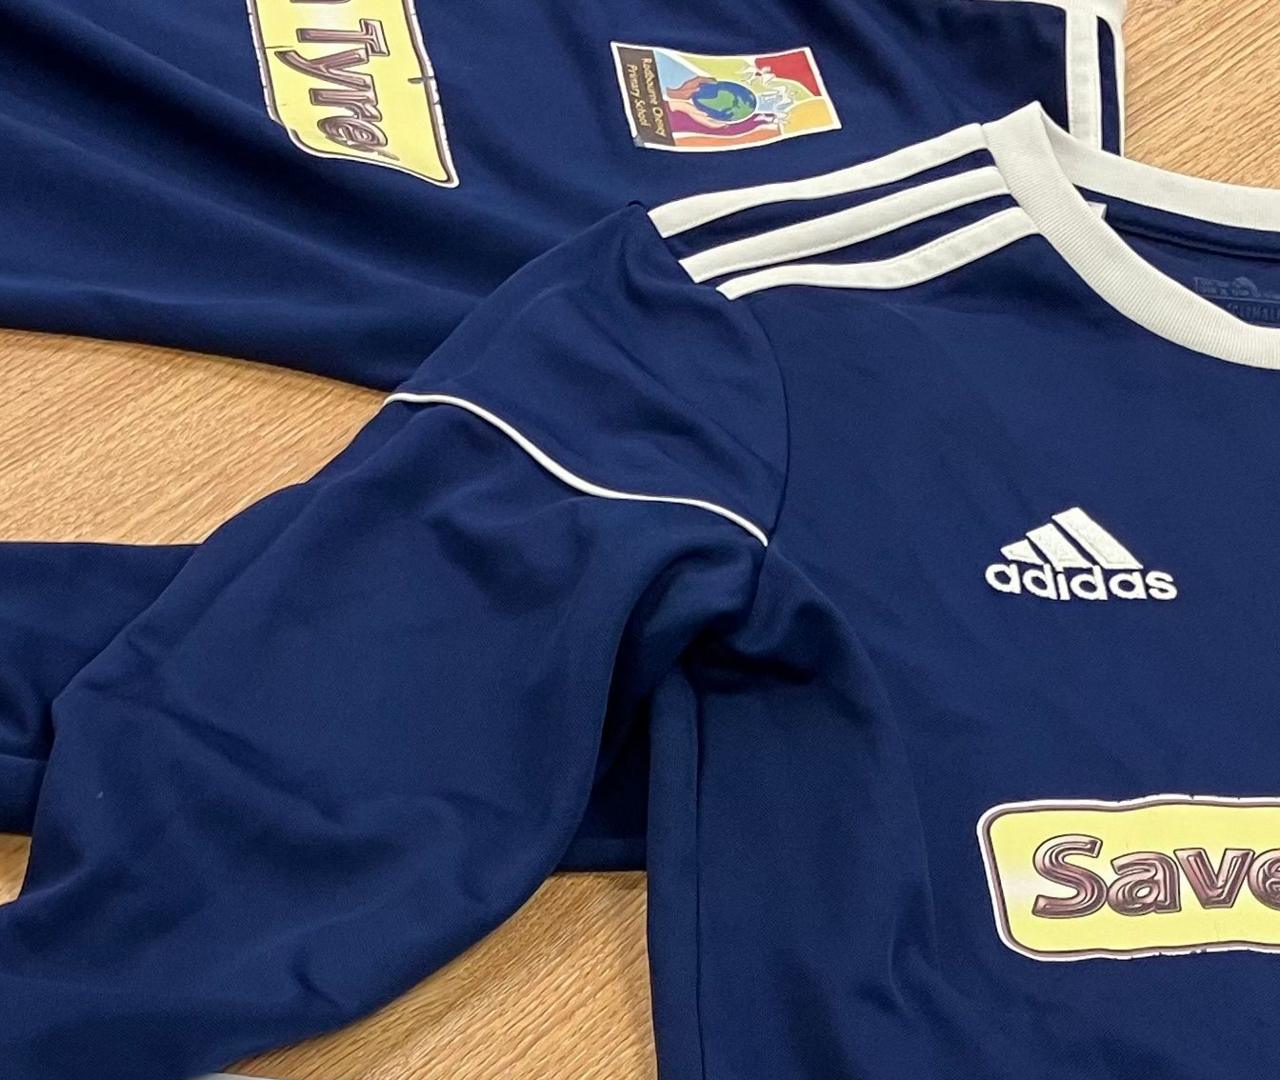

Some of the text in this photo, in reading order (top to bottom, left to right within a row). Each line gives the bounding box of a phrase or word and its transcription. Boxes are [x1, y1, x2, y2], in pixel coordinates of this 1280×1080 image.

[274, 18, 390, 151] Tyre
[628, 64, 650, 127] Primary School
[642, 58, 658, 104] Rodbourne
[986, 561, 1178, 601] adidas
